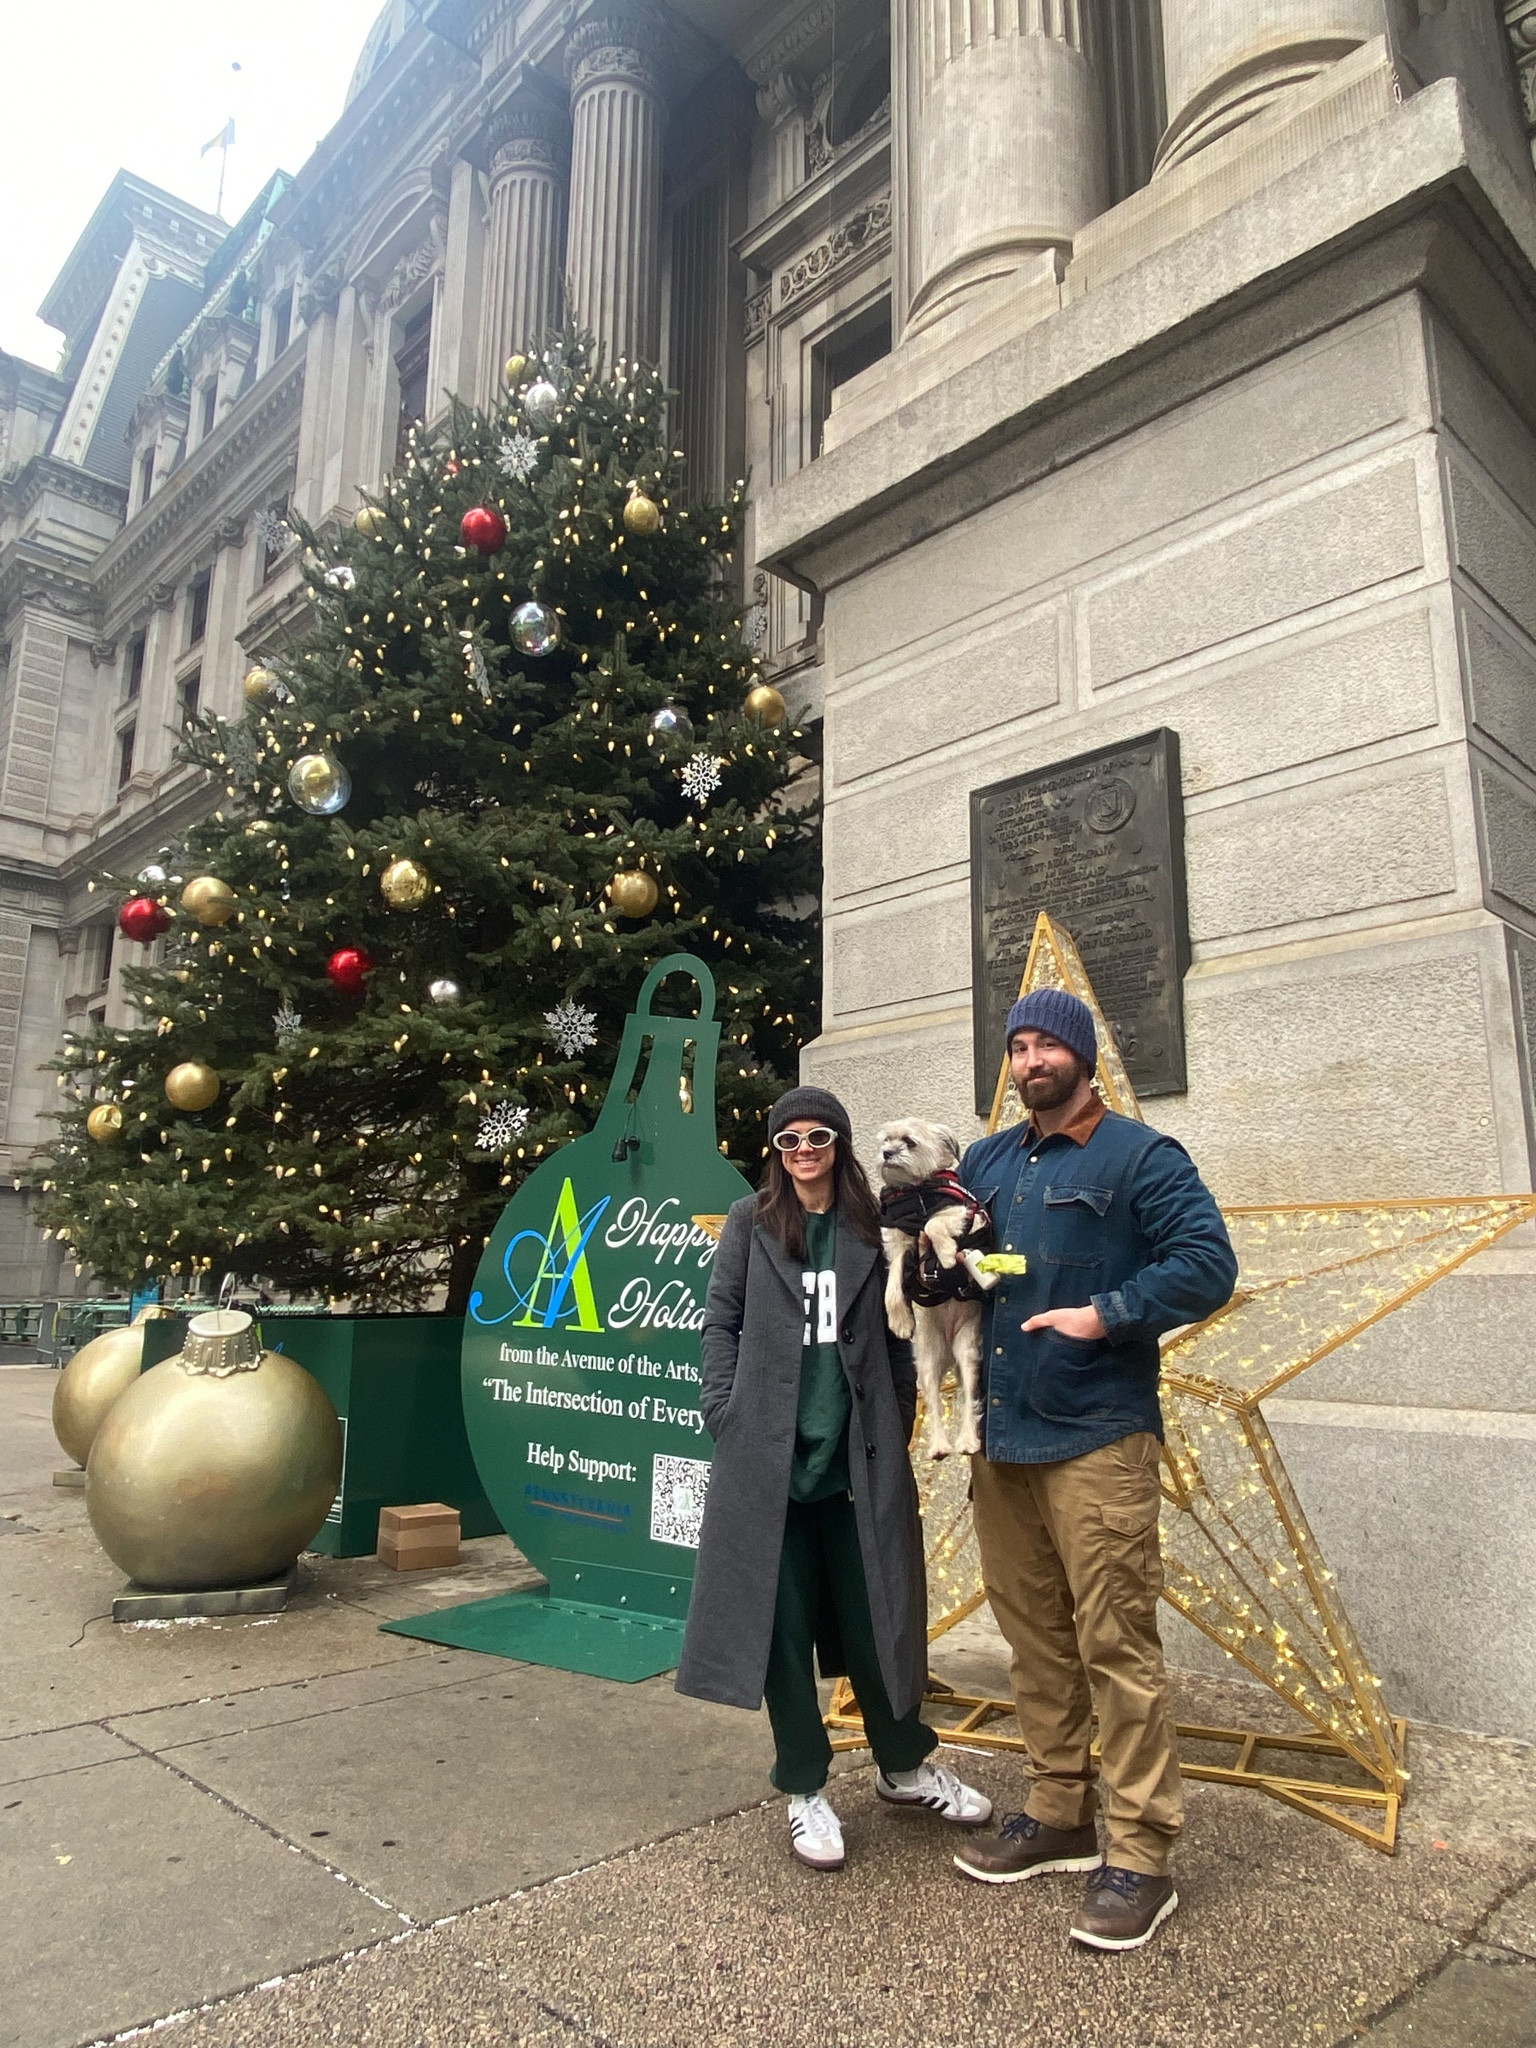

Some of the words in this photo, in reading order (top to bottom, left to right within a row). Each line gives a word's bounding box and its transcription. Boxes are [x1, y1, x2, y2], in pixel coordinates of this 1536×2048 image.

[605, 1197, 720, 1268] Happy
[499, 1342, 533, 1364] from
[536, 1346, 559, 1367] the
[560, 1349, 614, 1372] Avenue
[618, 1353, 635, 1374] of
[637, 1355, 662, 1378] the
[664, 1360, 703, 1386] Arts,
[526, 1381, 623, 1417] Intersection
[628, 1396, 651, 1420] of
[526, 1442, 564, 1474] Help
[568, 1449, 637, 1482] Support:
